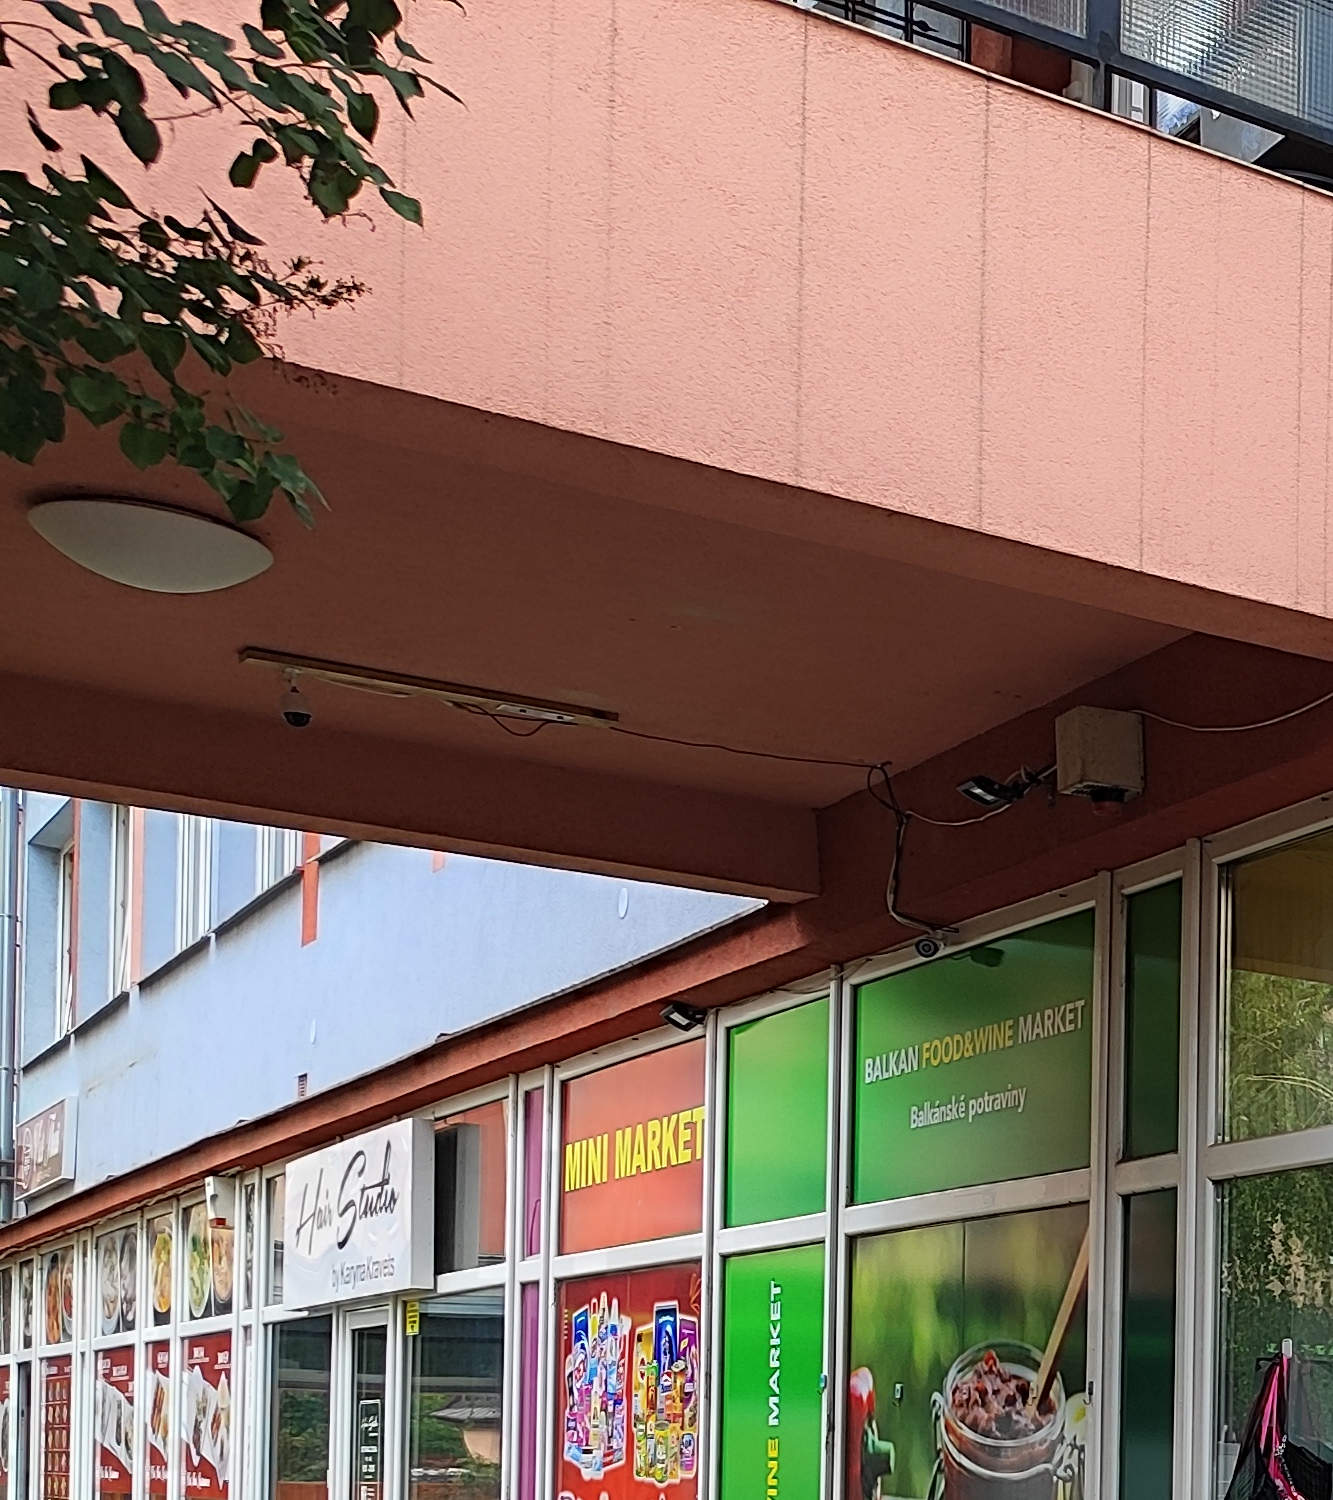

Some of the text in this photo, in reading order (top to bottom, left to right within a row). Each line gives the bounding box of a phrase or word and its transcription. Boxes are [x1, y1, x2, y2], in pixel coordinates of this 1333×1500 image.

[865, 1000, 1085, 1084] BALKAN FOOD&WINE MARKET
[565, 1105, 706, 1192] MINI MARKET
[910, 1084, 1026, 1129] Balkánské potraviny
[296, 1140, 399, 1256] Hair Studio
[768, 1280, 783, 1427] MARKET
